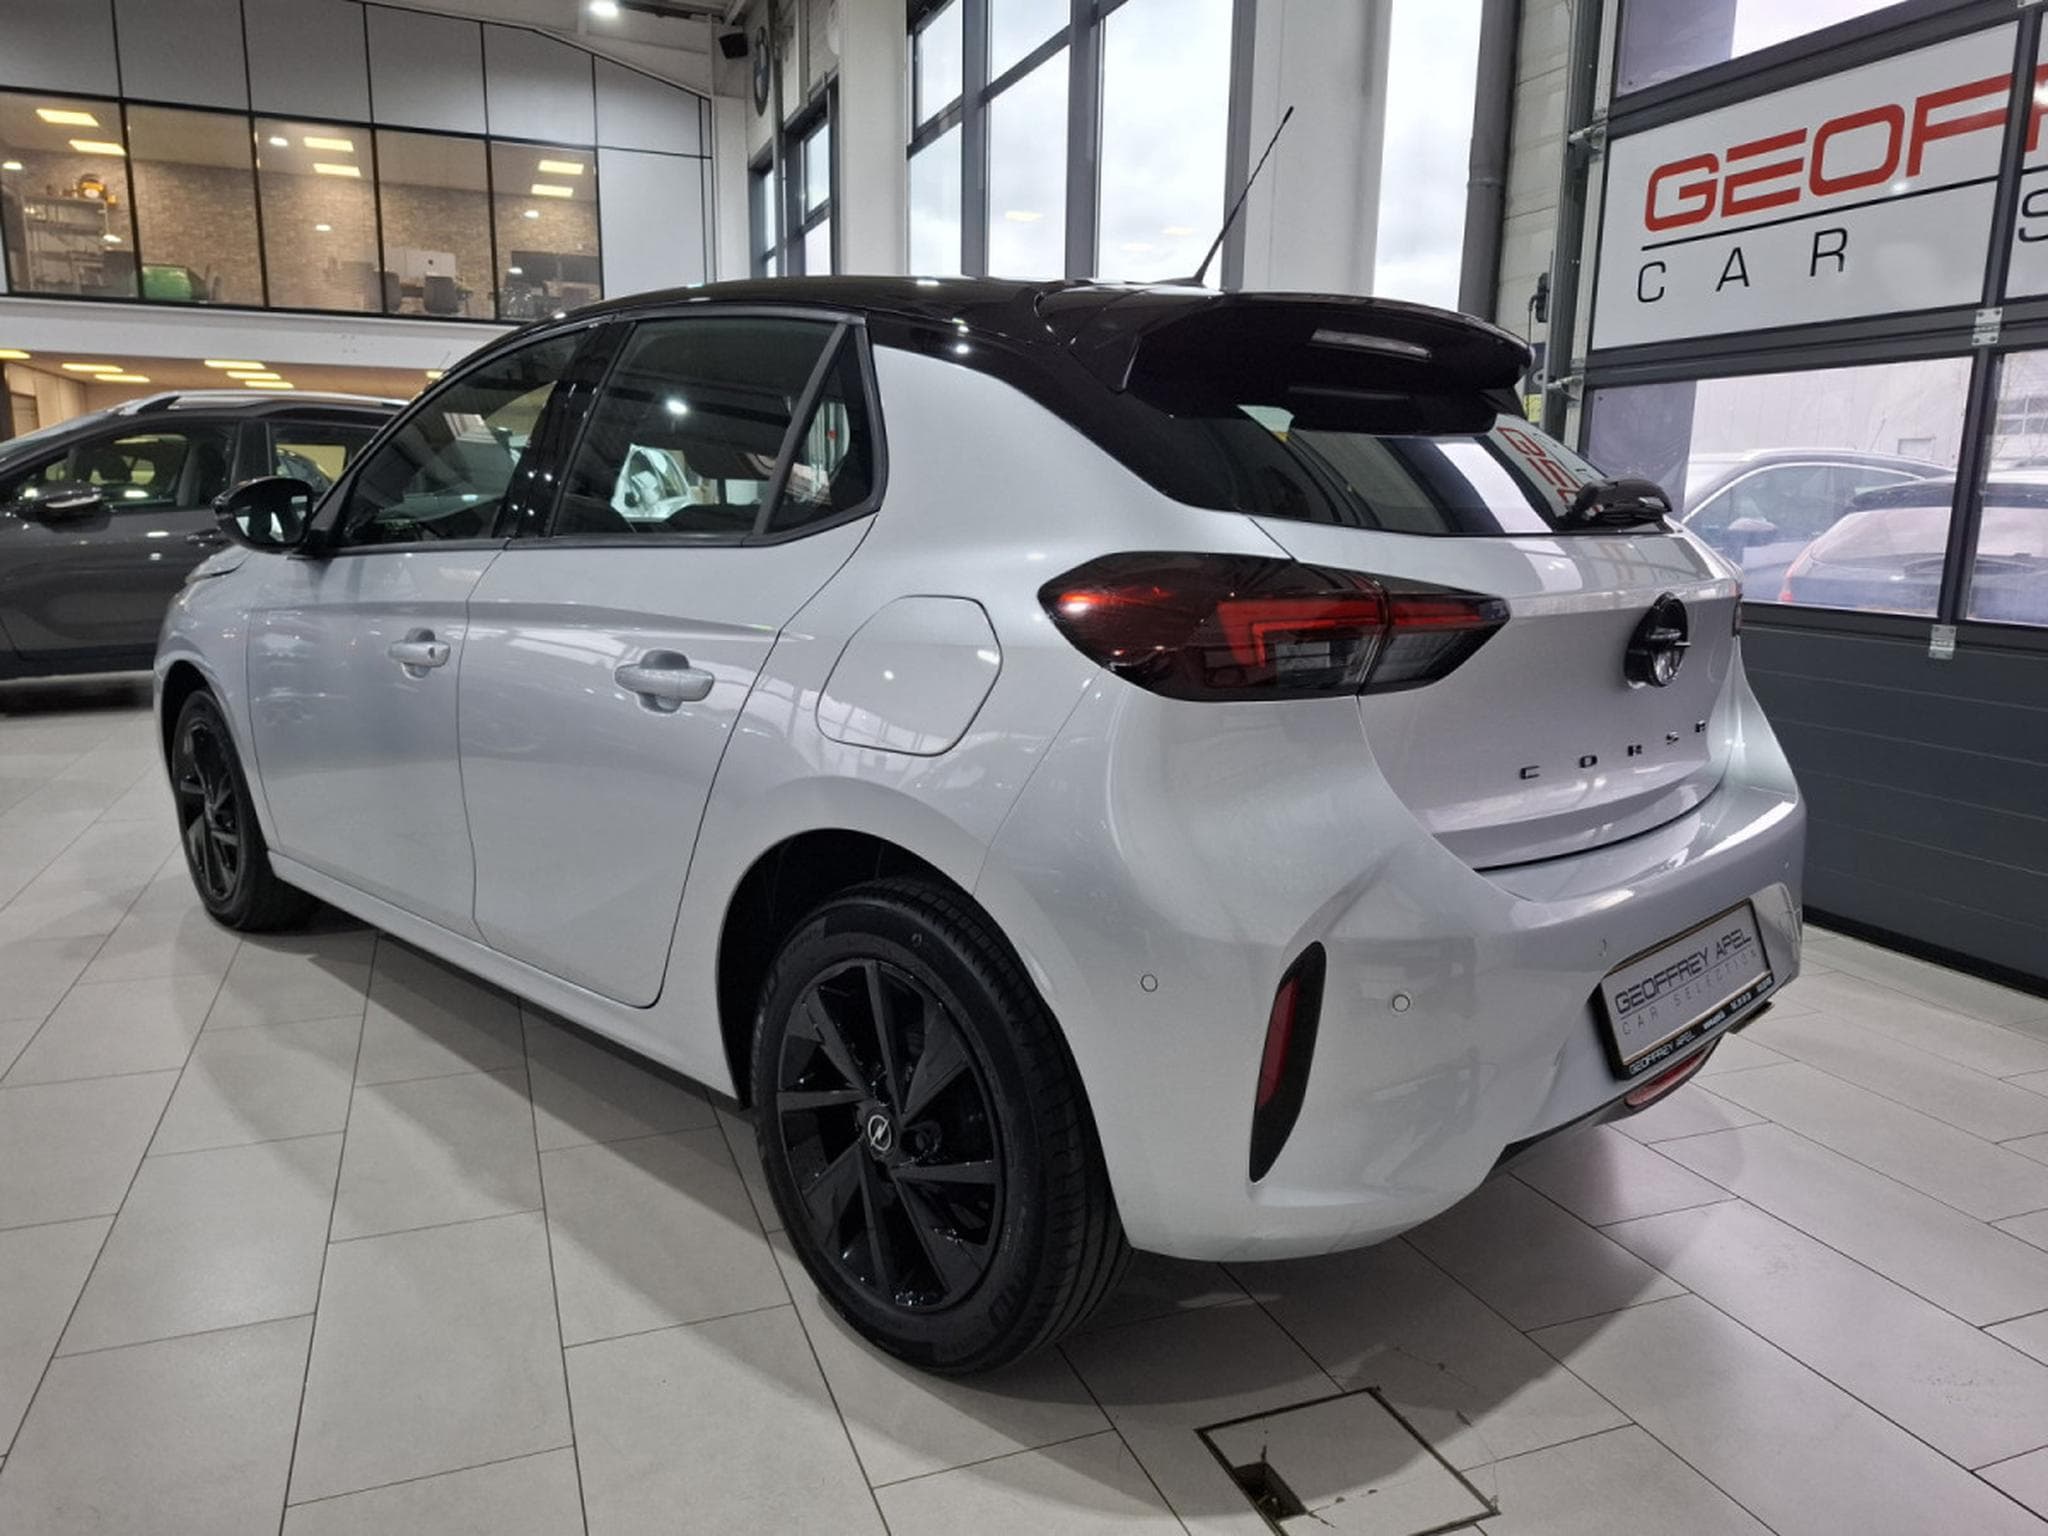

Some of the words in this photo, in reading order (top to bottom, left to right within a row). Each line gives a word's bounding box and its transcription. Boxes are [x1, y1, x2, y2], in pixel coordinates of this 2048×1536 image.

[1636, 227, 1848, 303] CAR
[1519, 719, 1706, 780] CORSA
[1614, 946, 1709, 1014] GEOFFREY
[1716, 928, 1752, 960] APEL
[1621, 1005, 1658, 1036] CAR
